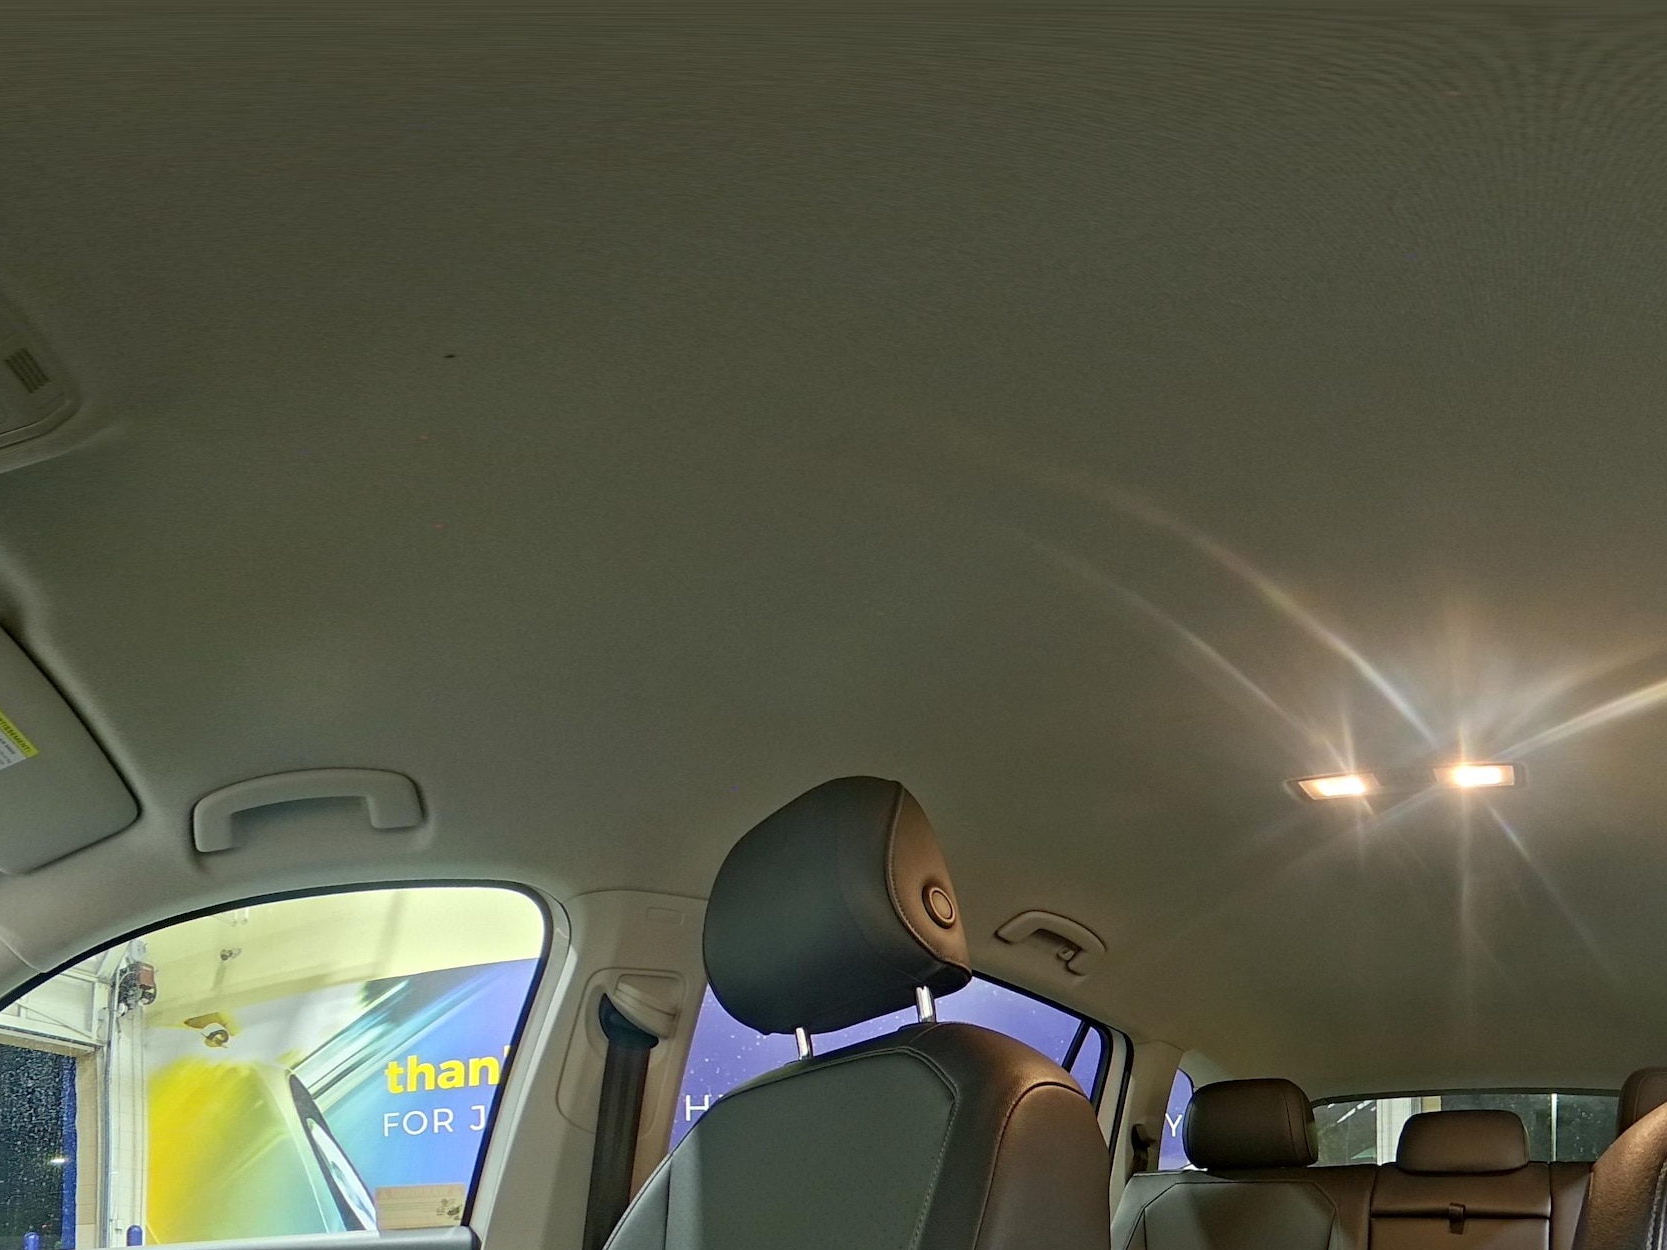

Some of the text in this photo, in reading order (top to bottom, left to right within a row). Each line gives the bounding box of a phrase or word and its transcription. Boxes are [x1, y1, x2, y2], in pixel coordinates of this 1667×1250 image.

[384, 1045, 511, 1094] than
[382, 1104, 487, 1137] FOR J
